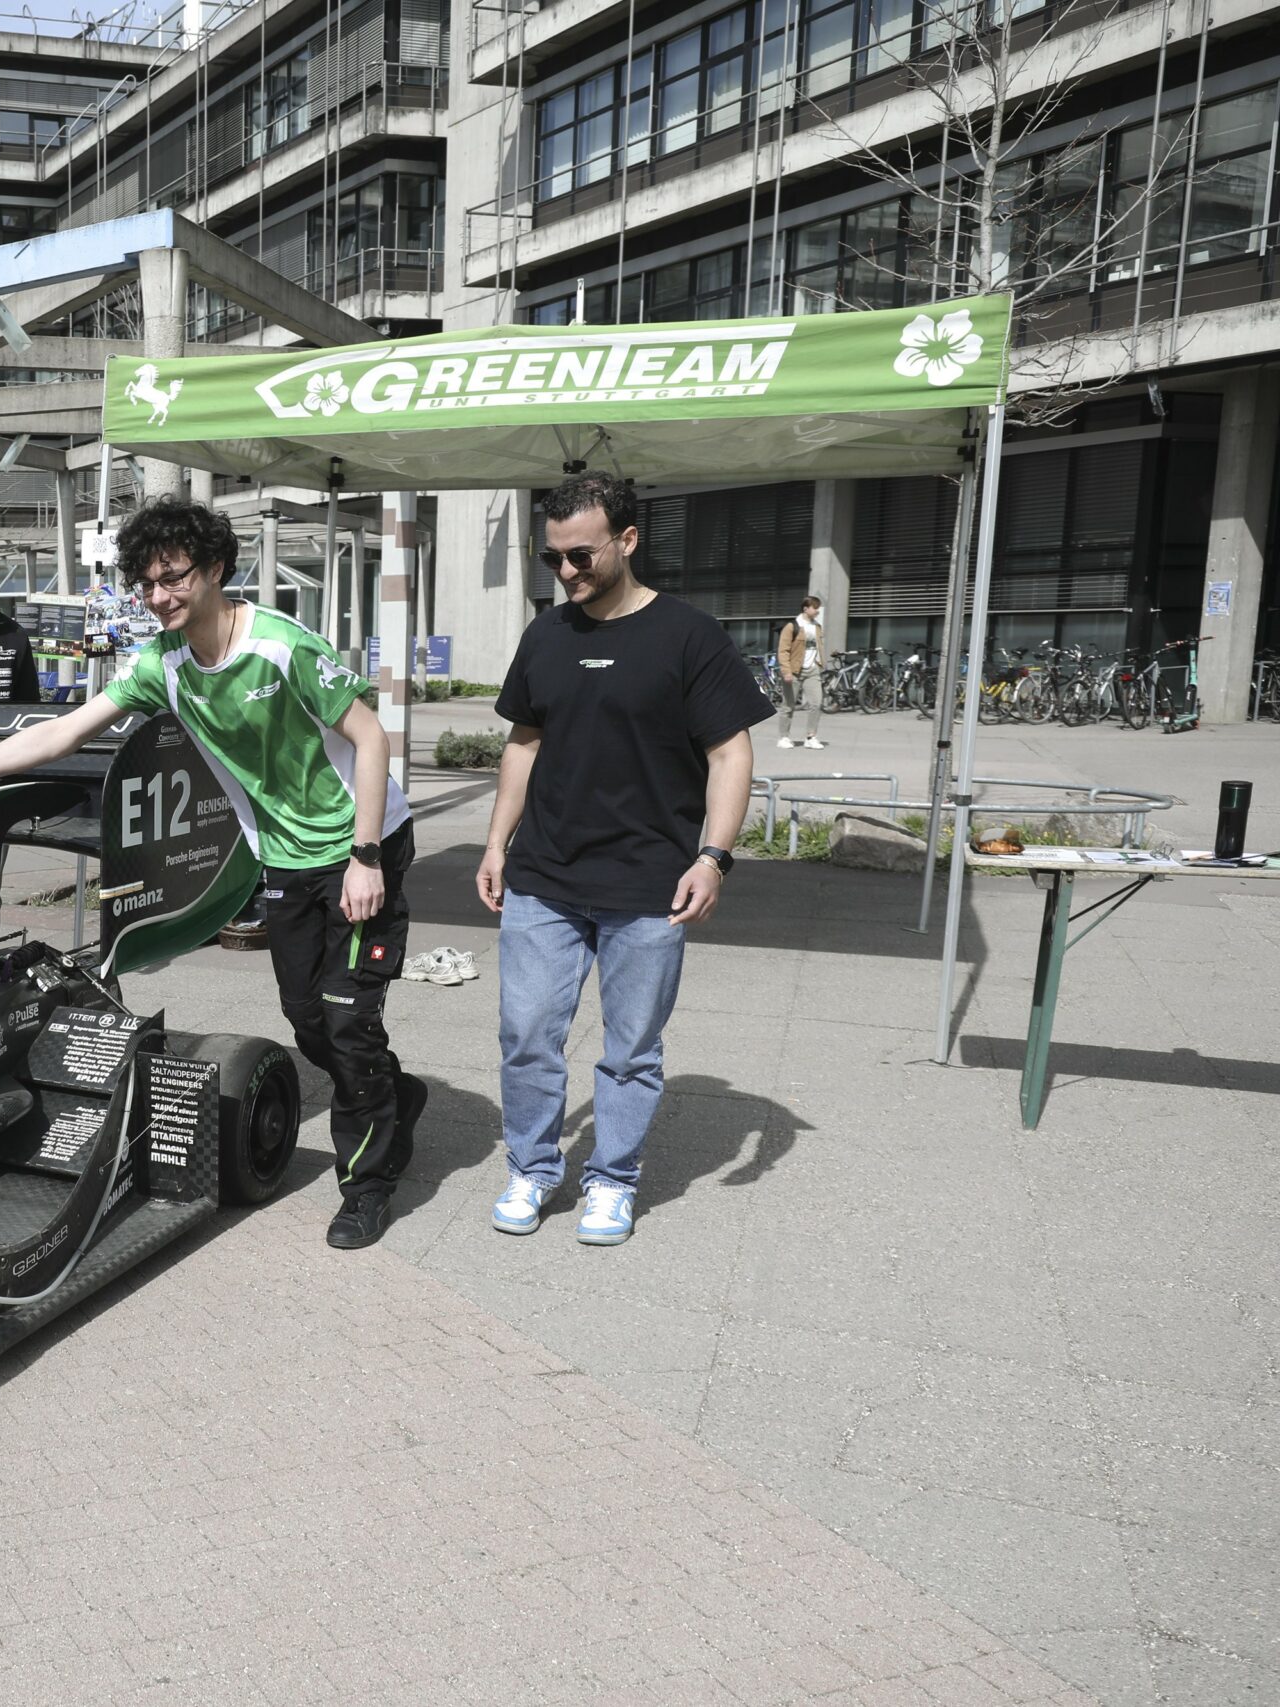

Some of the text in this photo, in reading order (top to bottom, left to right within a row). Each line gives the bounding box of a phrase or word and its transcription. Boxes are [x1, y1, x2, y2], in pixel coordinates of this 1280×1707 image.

[351, 340, 789, 414] GREENTEAM
[429, 384, 756, 409] UNI STUTTGART
[122, 769, 191, 848] E12
[197, 795, 233, 816] RENISHA
[166, 844, 219, 866] Porsche Engineering
[124, 888, 163, 913] manz
[15, 1005, 39, 1023] Pulse
[164, 1059, 188, 1068] WOLLEN
[76, 1074, 106, 1084] EPLAN
[151, 1066, 210, 1081] SALTANDPEPPER
[151, 1076, 203, 1089] KS ENGINEERS
[151, 1113, 198, 1125] speedgoat
[160, 1143, 187, 1154] MAGNA
[151, 1152, 187, 1167] MAHLE
